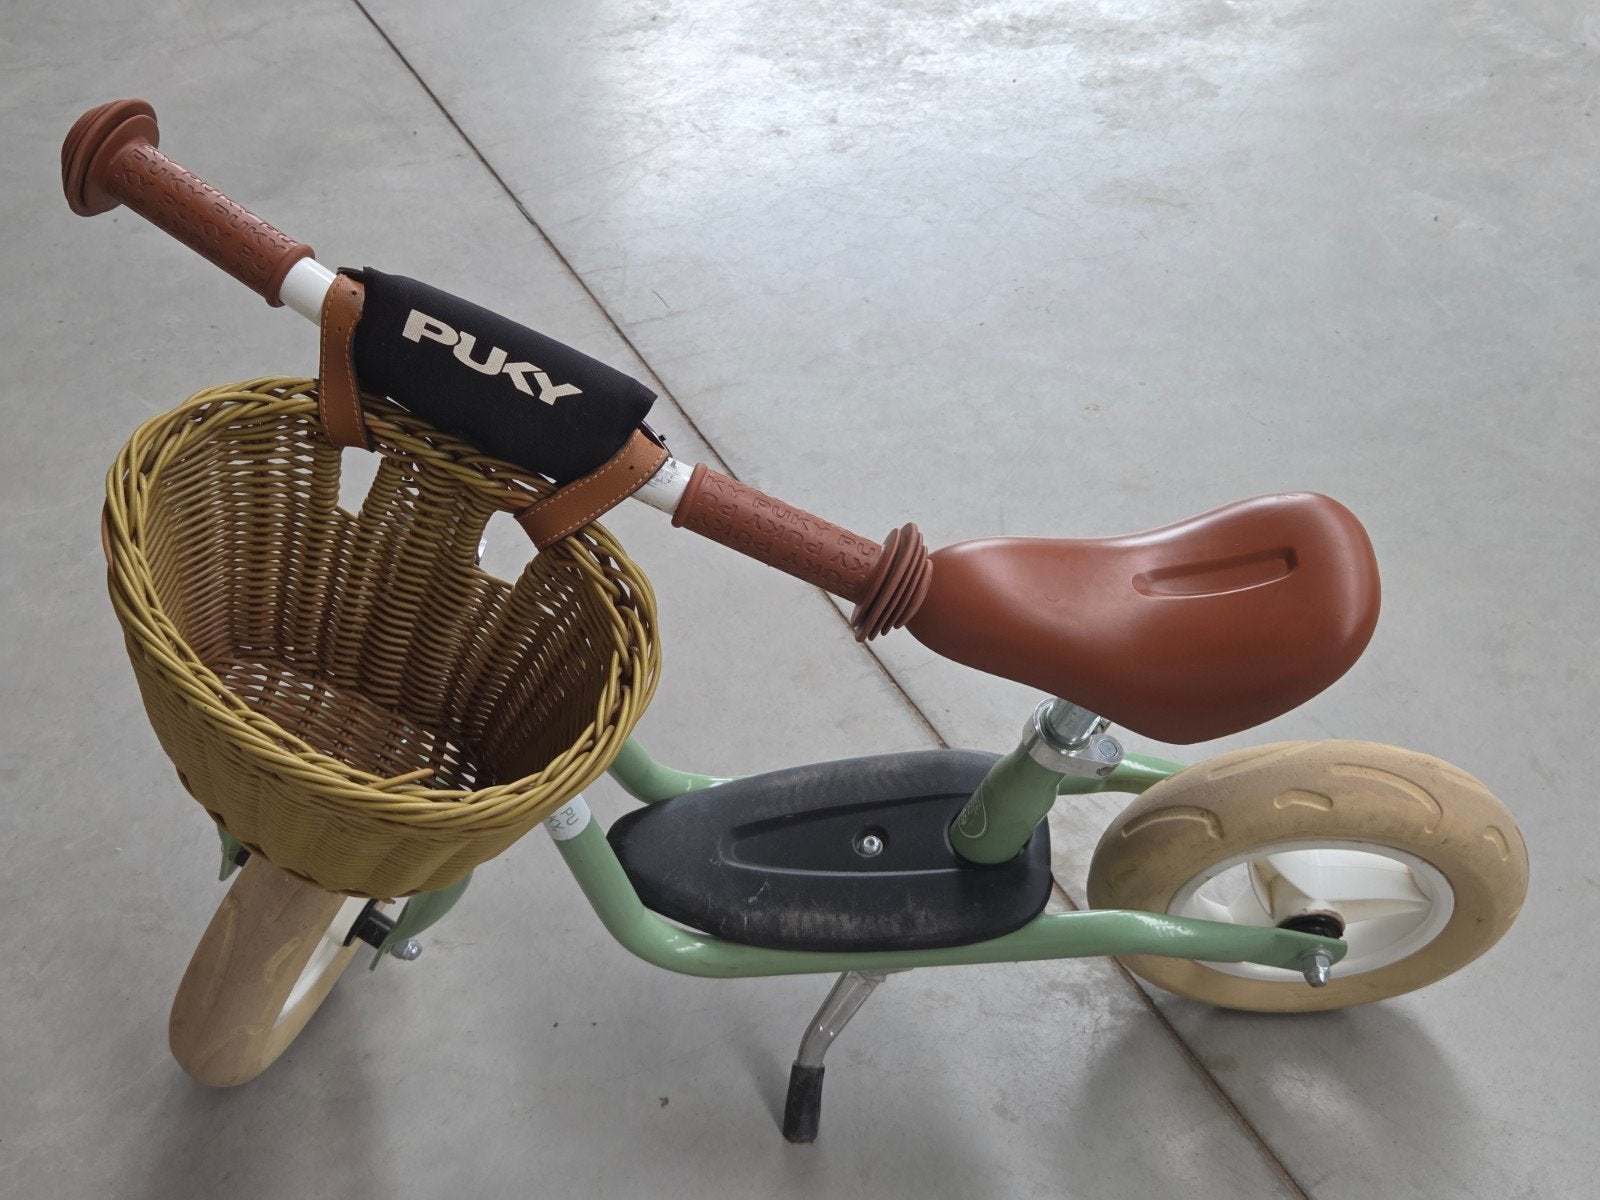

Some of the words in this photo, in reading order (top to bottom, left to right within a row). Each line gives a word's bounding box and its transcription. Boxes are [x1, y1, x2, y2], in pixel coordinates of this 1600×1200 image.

[127, 149, 205, 200] PUKY
[210, 202, 287, 252] PUKY
[402, 309, 583, 406] PUKY
[743, 513, 824, 555] PUKY
[752, 497, 830, 535] PUKY
[838, 534, 875, 557] PU
[560, 806, 579, 826] PU
